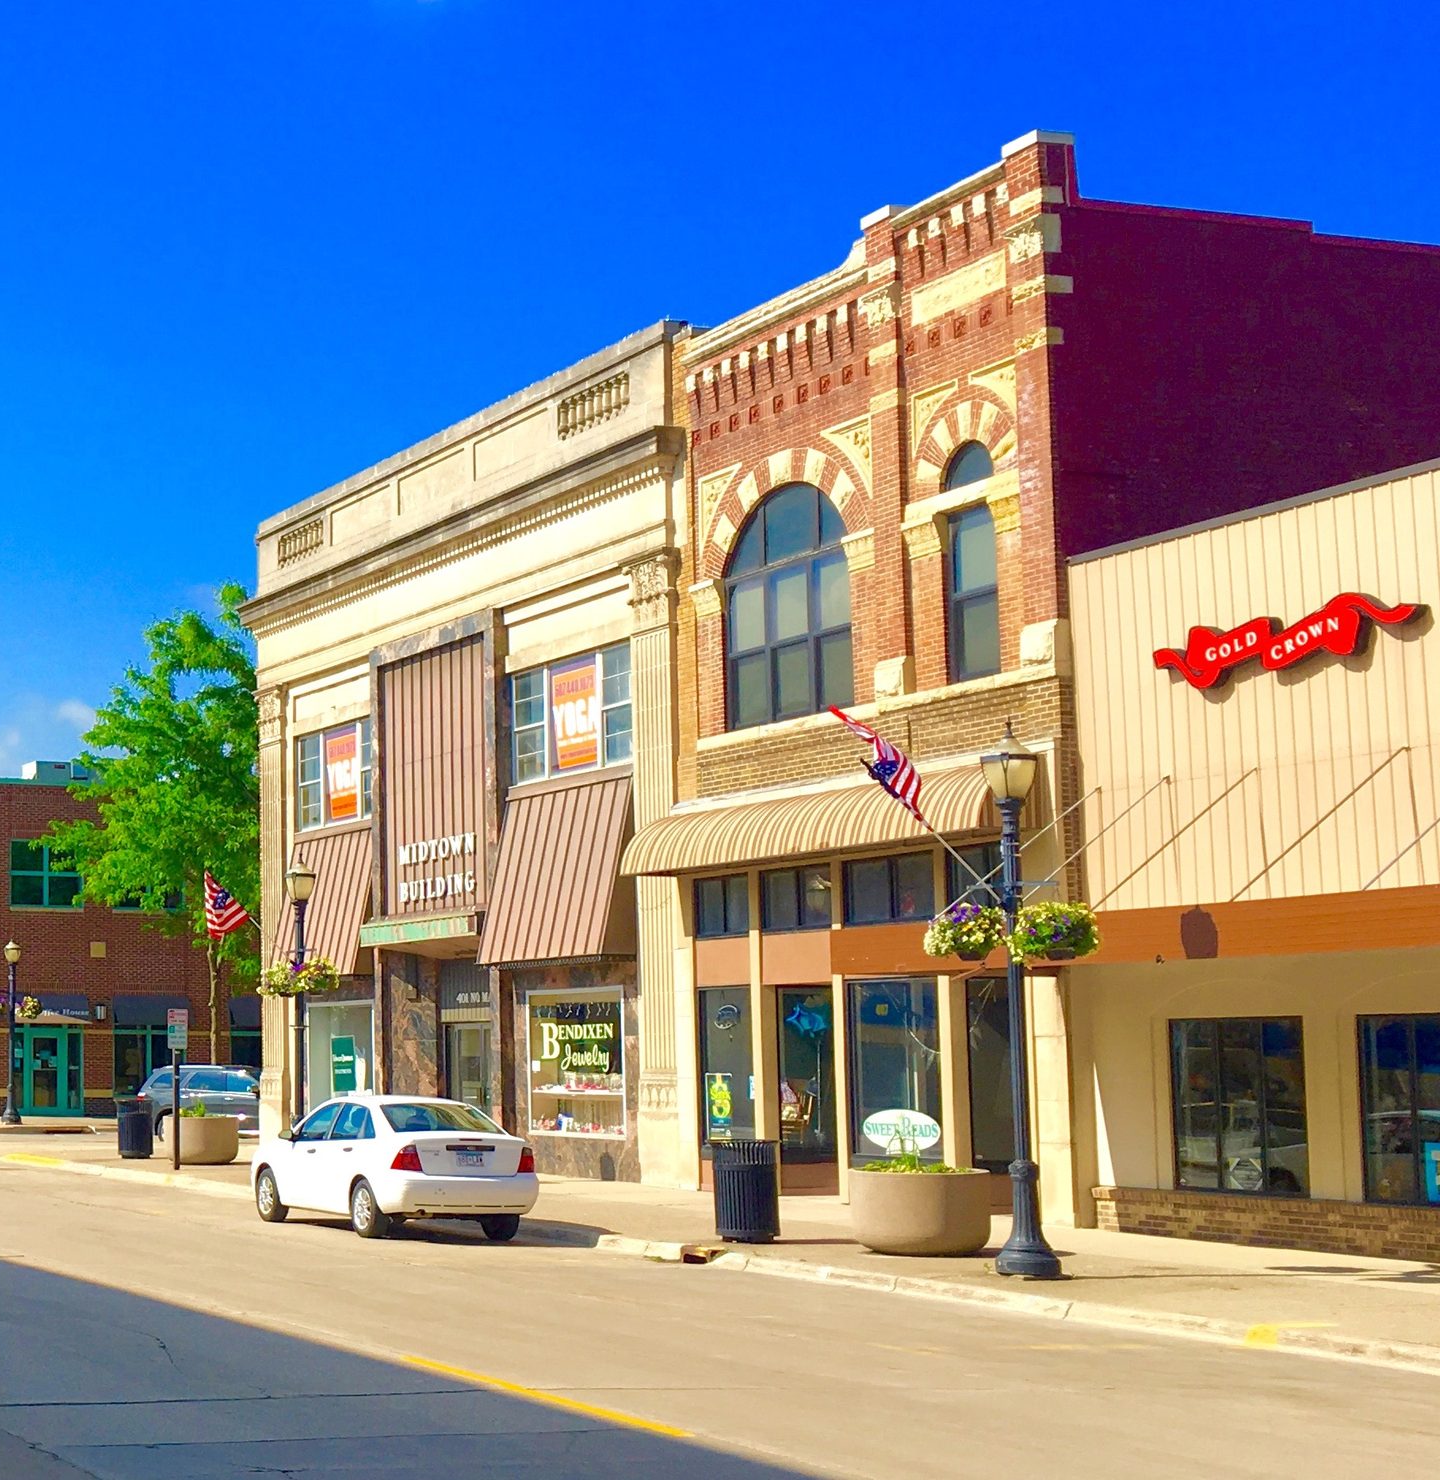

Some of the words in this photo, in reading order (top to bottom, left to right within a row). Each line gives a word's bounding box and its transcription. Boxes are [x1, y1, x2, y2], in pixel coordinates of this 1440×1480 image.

[1205, 631, 1257, 661] GOLD
[1270, 617, 1340, 660] CROWN
[399, 832, 475, 865] MIDTOWN
[399, 871, 475, 903] BUILDING
[540, 1023, 614, 1059] BENDIXEN
[560, 1044, 610, 1073] Jewelry
